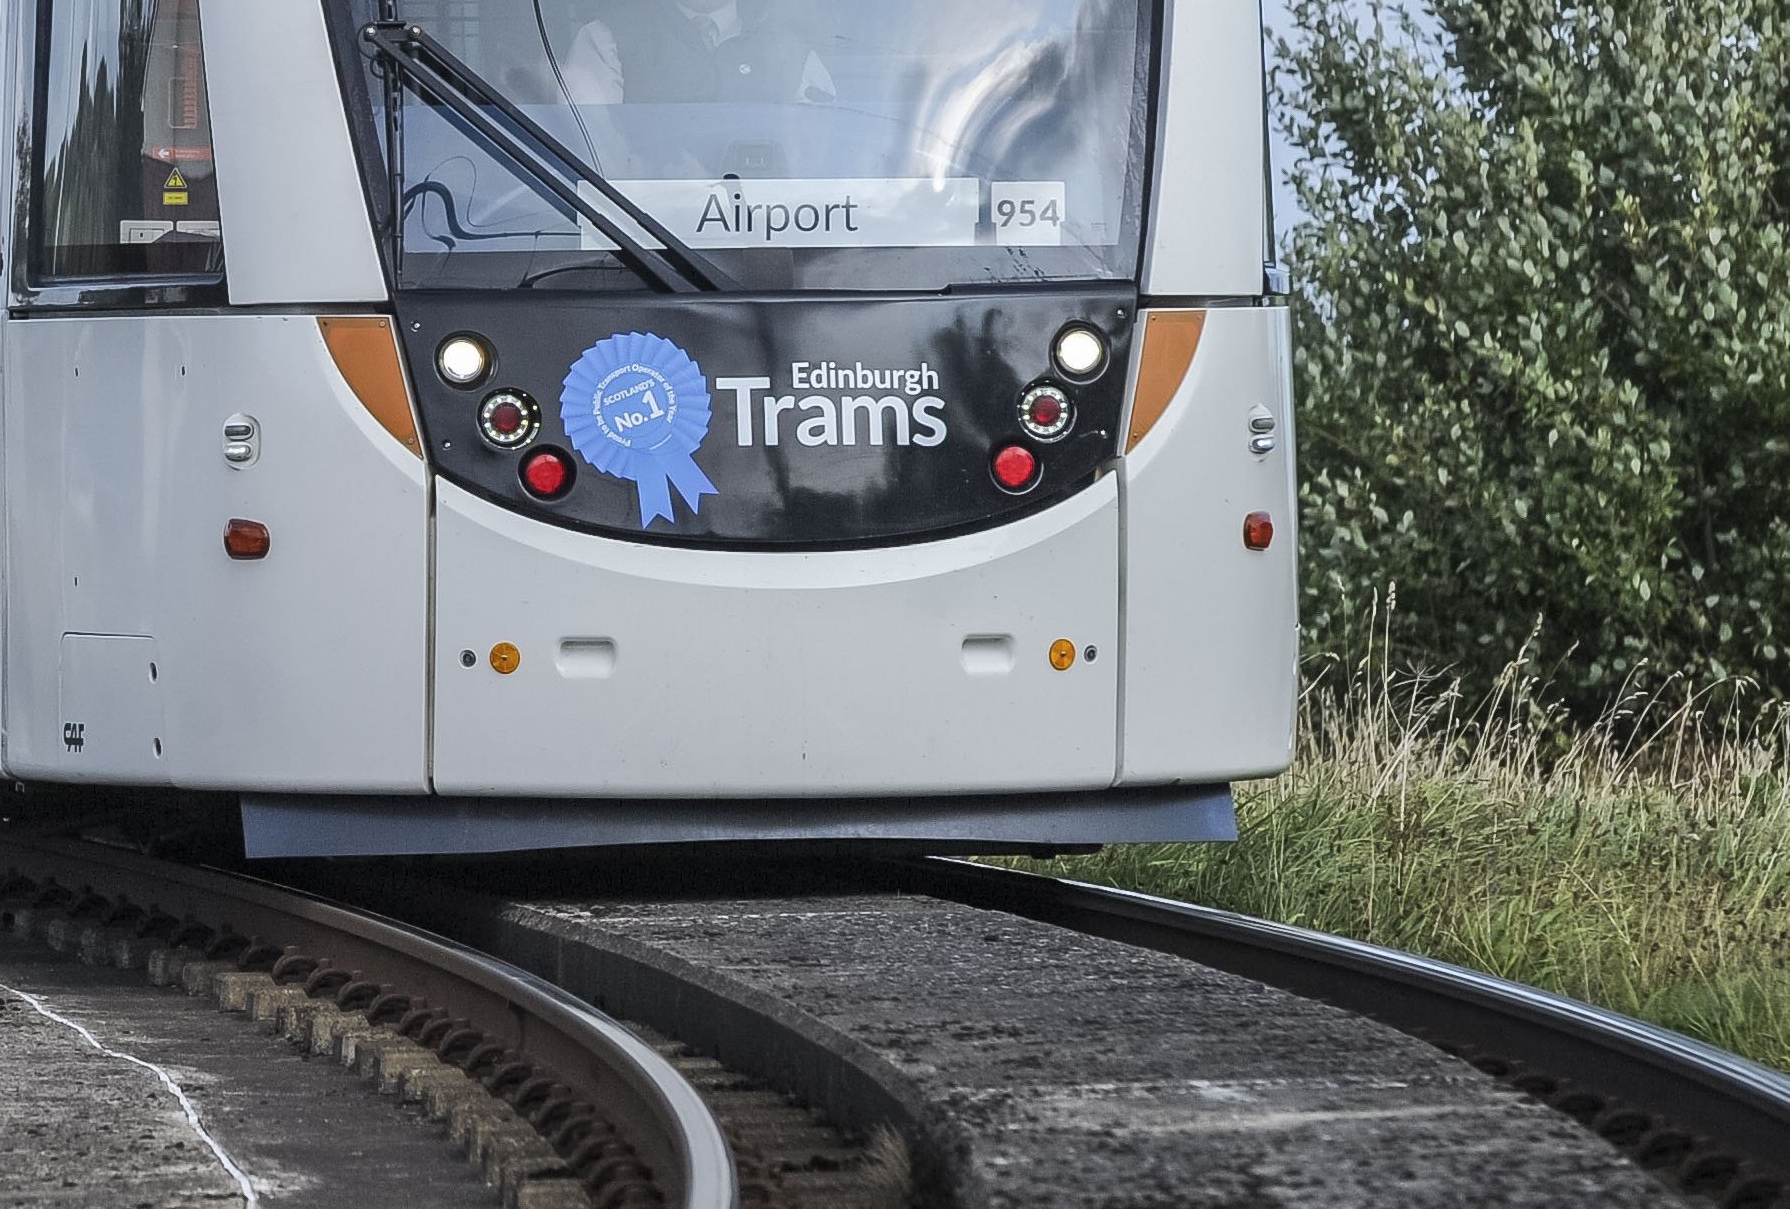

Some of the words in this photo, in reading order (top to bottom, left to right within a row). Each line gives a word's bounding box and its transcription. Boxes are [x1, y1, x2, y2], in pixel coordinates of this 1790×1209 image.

[697, 193, 858, 240] Airport
[997, 199, 1060, 228] 954
[598, 365, 631, 389] Transport
[632, 363, 665, 383] Operator
[792, 362, 939, 395] Edinburgh
[603, 378, 655, 406] SCOTLAND'S
[716, 377, 947, 447] Trams
